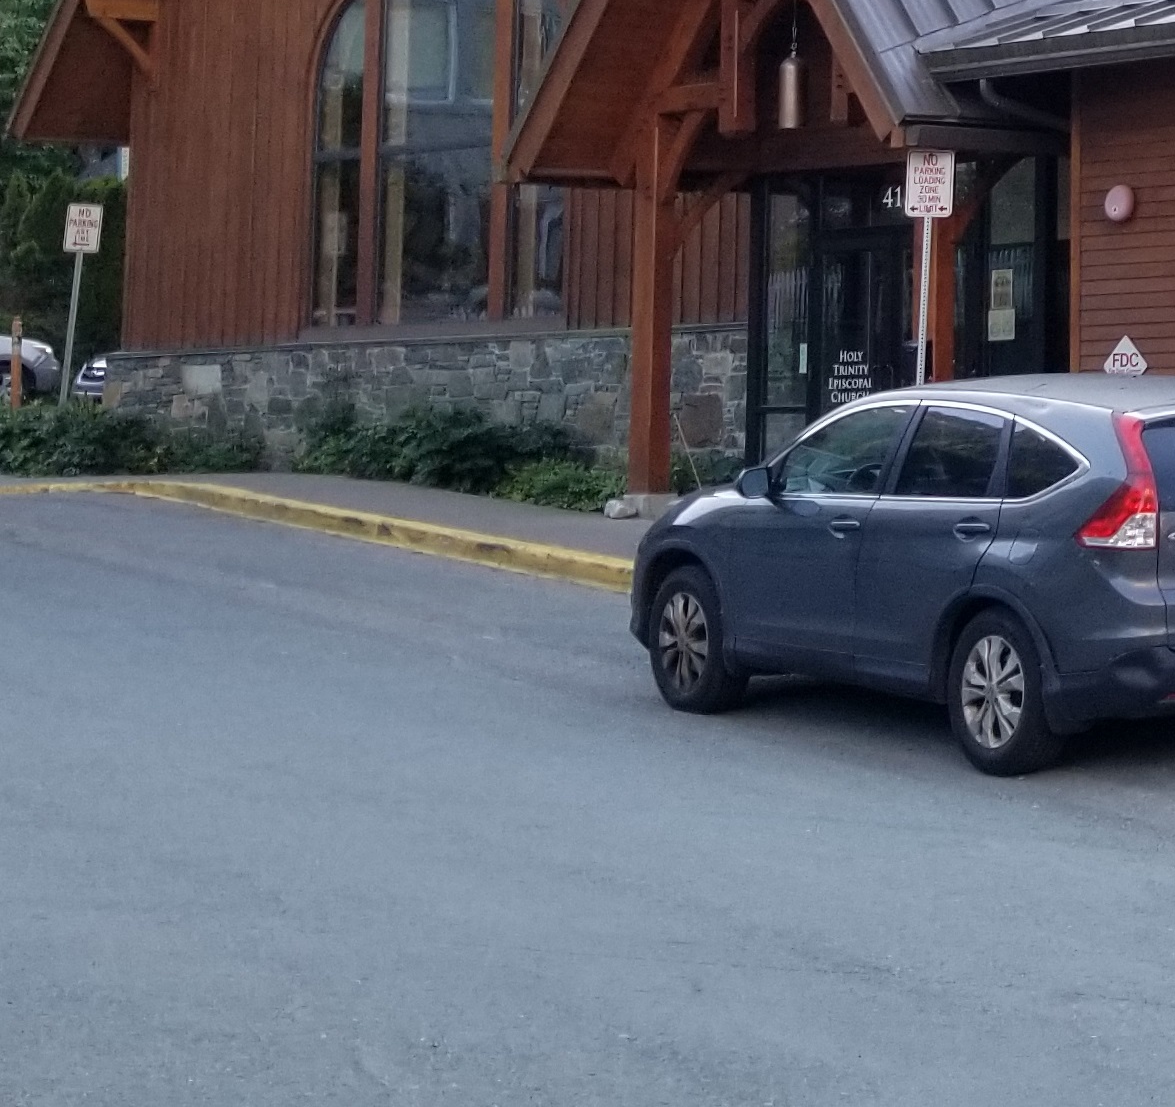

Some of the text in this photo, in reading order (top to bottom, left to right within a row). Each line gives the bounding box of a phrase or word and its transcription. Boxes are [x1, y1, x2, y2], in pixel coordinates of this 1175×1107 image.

[923, 154, 938, 166] NO
[914, 167, 945, 176] PARKING
[913, 176, 945, 185] LOADING
[919, 185, 939, 194] ZONE
[927, 195, 941, 204] MIN
[78, 208, 91, 218] NO
[919, 205, 938, 213] LIMIT
[69, 219, 98, 229] PARKING
[839, 349, 864, 362] HOLY
[1112, 352, 1139, 368] FDC
[832, 364, 869, 376] TRINITY
